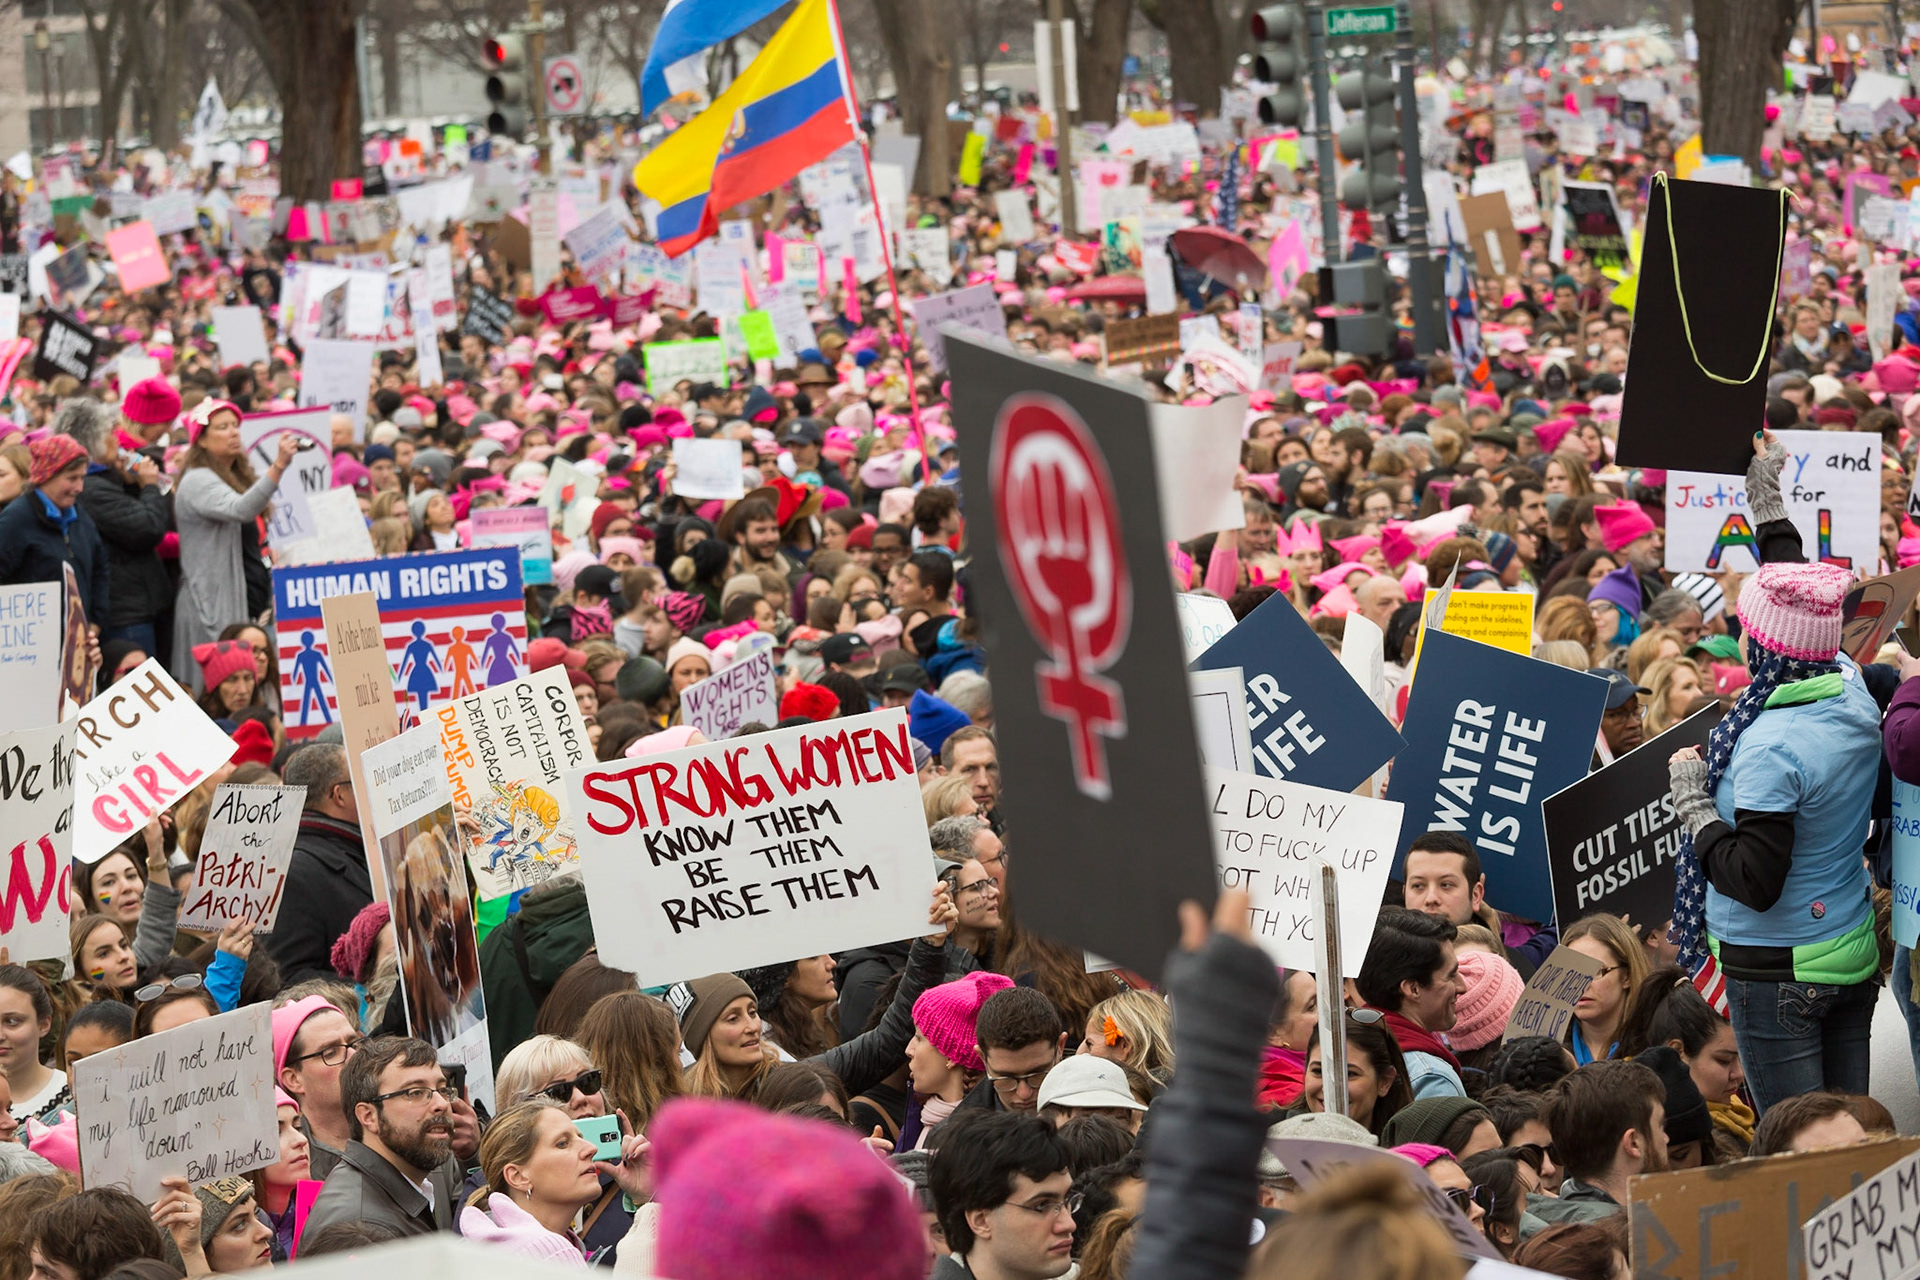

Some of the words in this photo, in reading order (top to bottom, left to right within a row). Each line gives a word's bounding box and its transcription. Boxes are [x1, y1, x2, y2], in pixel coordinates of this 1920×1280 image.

[1329, 11, 1387, 34] Jefferson
[1825, 446, 1872, 472] and
[1790, 485, 1826, 503] for
[285, 570, 392, 609] HUMAN
[399, 559, 508, 599] RIGHTS
[1448, 599, 1468, 609] don't
[1469, 600, 1489, 610] make
[1490, 601, 1519, 614] progress
[1519, 600, 1528, 613] by
[1472, 628, 1488, 636] and
[1481, 614, 1493, 623] the
[76, 670, 175, 760] RCH
[491, 695, 508, 721] IS
[501, 723, 527, 760] NOT
[515, 683, 562, 786] CAPITALISM
[692, 680, 768, 735] RIGHTS
[437, 705, 476, 770] DUMP
[464, 696, 508, 788] DEMOCRACY
[1427, 698, 1497, 832] WATER
[1488, 710, 1547, 805] LIFE
[86, 764, 127, 793] like
[132, 750, 149, 762] a
[92, 751, 204, 834] GIRL
[373, 765, 387, 787] Did
[385, 763, 402, 786] your
[401, 755, 415, 775] dog
[413, 749, 425, 767] eat
[422, 744, 438, 768] your
[440, 731, 474, 809] TRUMP
[582, 746, 775, 836] STRONG
[764, 722, 917, 798] WOMEN
[387, 797, 402, 815] Tax
[643, 819, 735, 867] KNOW
[745, 798, 843, 839] THEM
[1246, 788, 1286, 820] DO
[1302, 801, 1347, 834] MY
[1476, 810, 1522, 857] IS
[1571, 826, 1619, 874] CUT
[1622, 791, 1676, 845] TIES
[240, 831, 272, 848] the
[683, 857, 729, 889] BE
[749, 834, 844, 869] THEM
[1219, 828, 1254, 854] TO
[1258, 833, 1327, 863] FUCK
[1341, 847, 1379, 873] UP
[661, 882, 772, 934] RAISE
[771, 864, 881, 911] THEM
[1576, 851, 1653, 911] FOSSIL
[1531, 963, 1564, 995] OUR
[1547, 1008, 1568, 1041] UP
[127, 1050, 166, 1094] will
[178, 1039, 208, 1074] not
[213, 1031, 258, 1064] have
[88, 1120, 118, 1160] my
[126, 1095, 159, 1144] life
[162, 1070, 240, 1117] narrowed
[186, 1153, 218, 1184] Bell
[223, 1138, 276, 1174] Hooks
[1807, 1181, 1886, 1270] GRAB
[1876, 1211, 1920, 1280] MY
